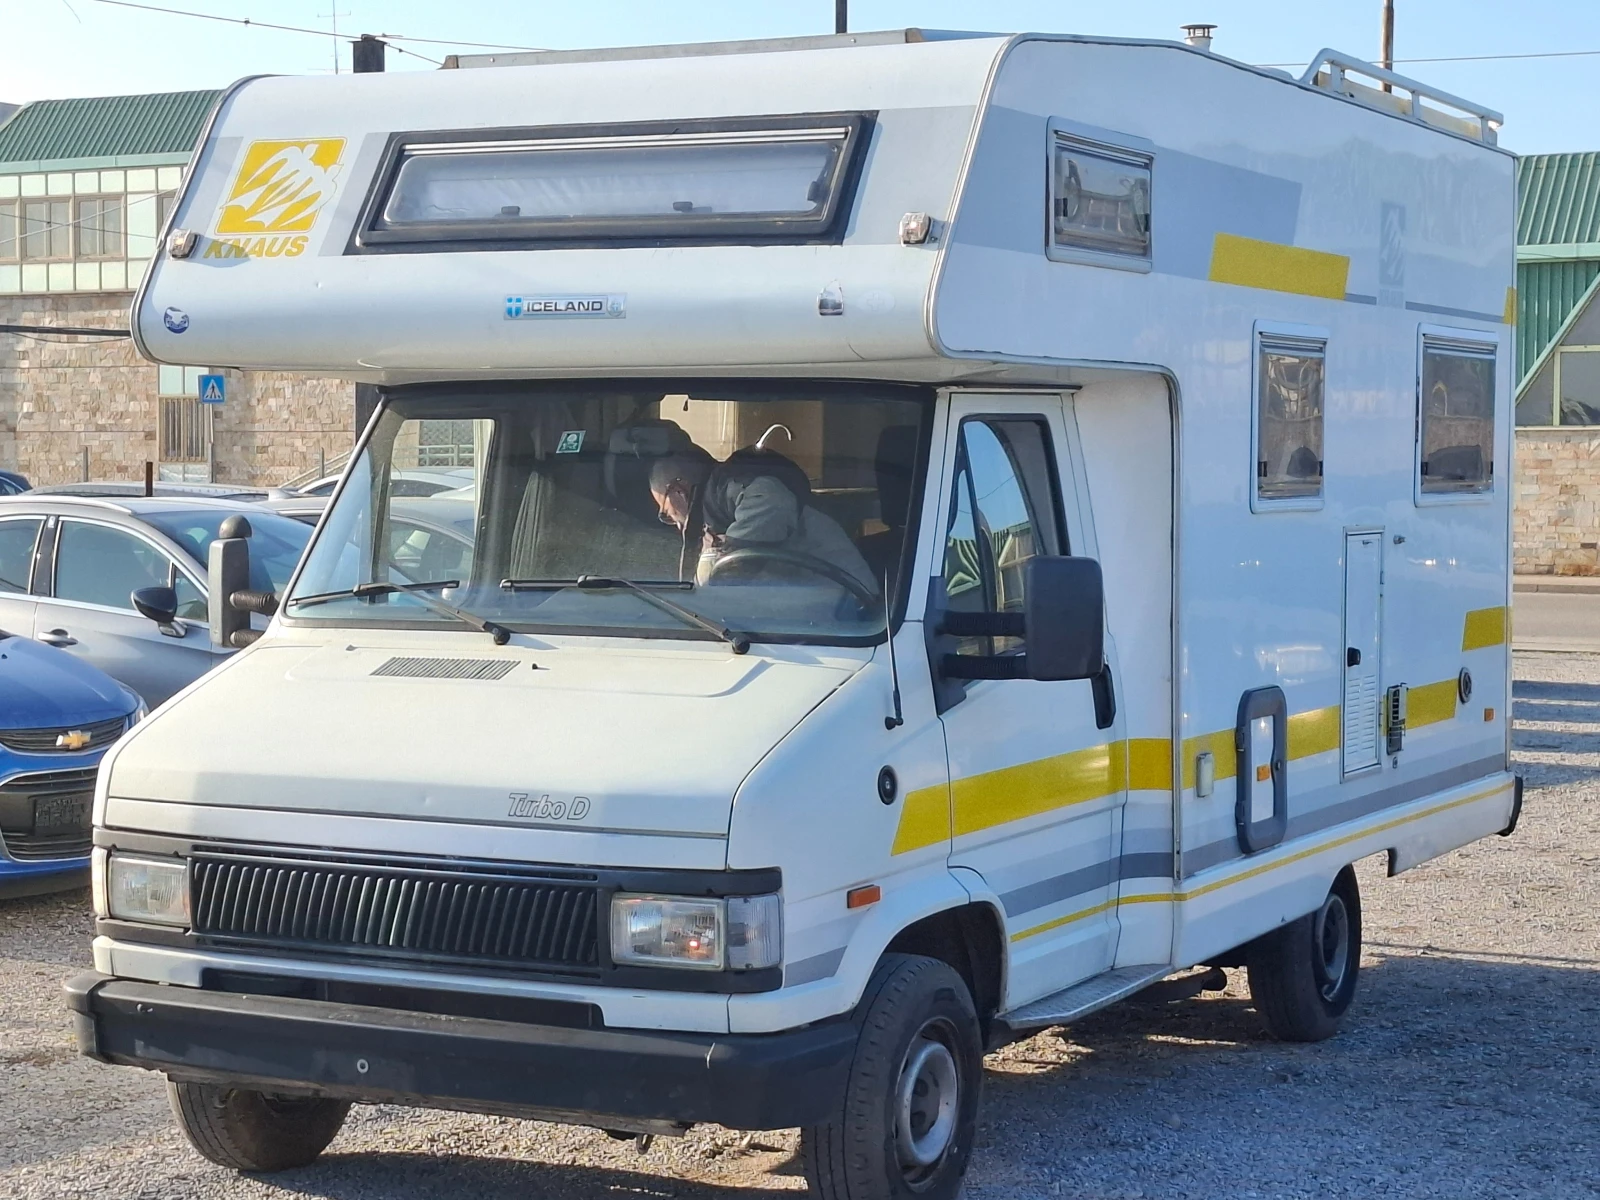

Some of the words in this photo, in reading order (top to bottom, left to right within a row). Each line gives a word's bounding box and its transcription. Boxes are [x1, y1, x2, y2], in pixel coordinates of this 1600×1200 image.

[203, 235, 309, 259] KNAUS
[526, 300, 603, 312] ICELAND
[508, 792, 567, 820] Turbo
[566, 796, 591, 820] D
